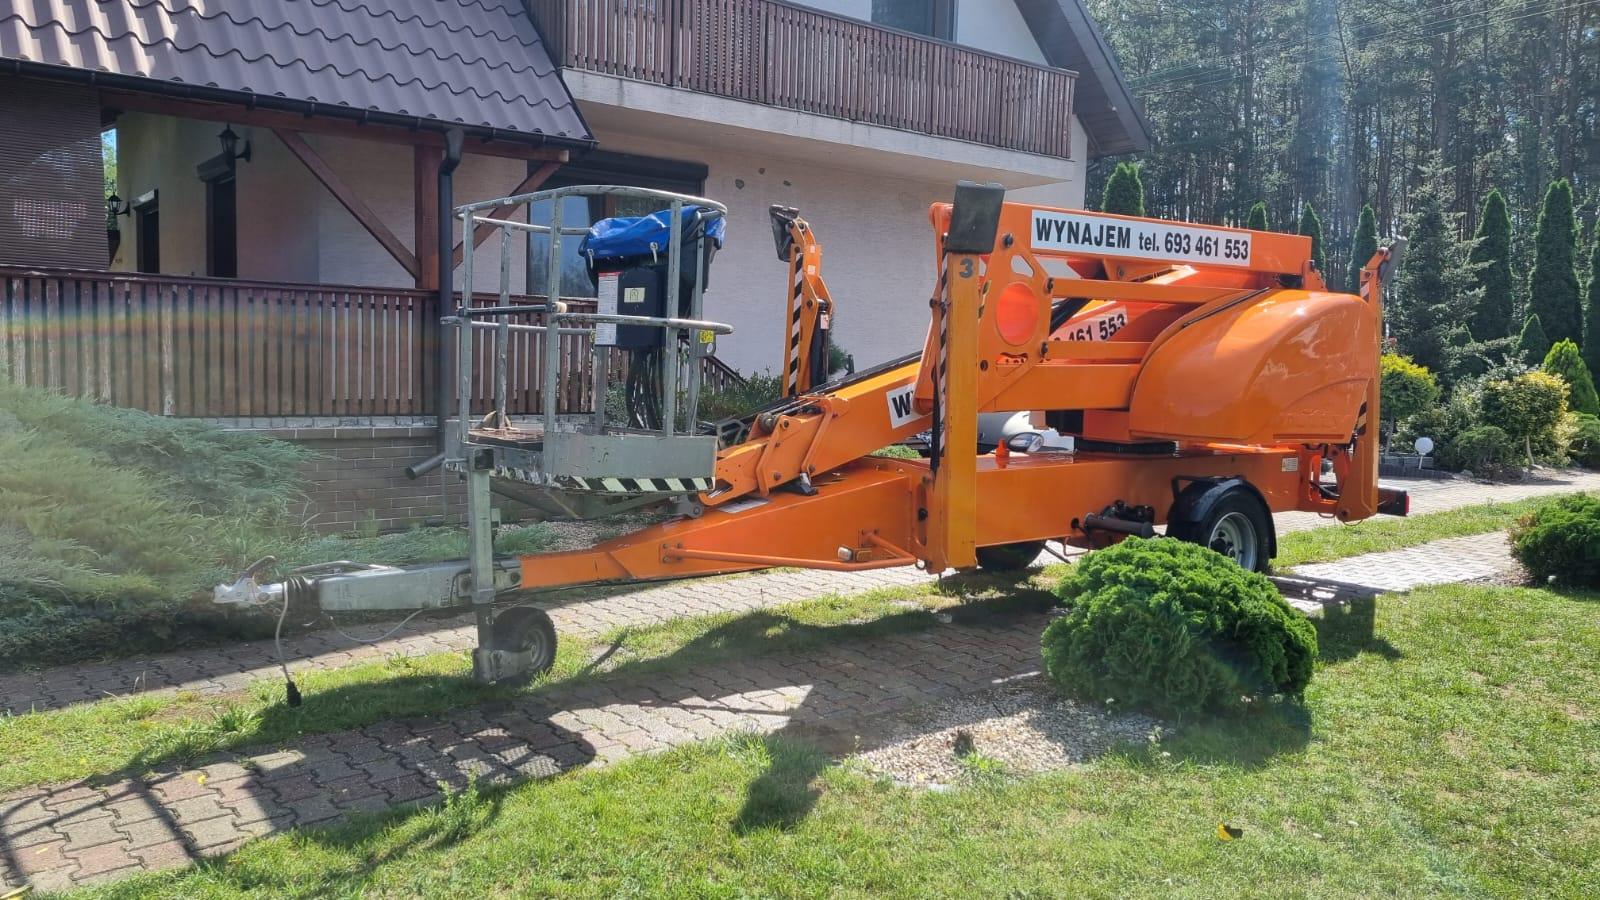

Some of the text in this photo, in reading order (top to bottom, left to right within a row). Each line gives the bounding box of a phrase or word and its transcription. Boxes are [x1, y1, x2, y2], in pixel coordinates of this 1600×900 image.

[1035, 217, 1249, 260] WYNAJEM tel. 693 461 553
[959, 257, 974, 279] 3
[891, 390, 914, 419] W
